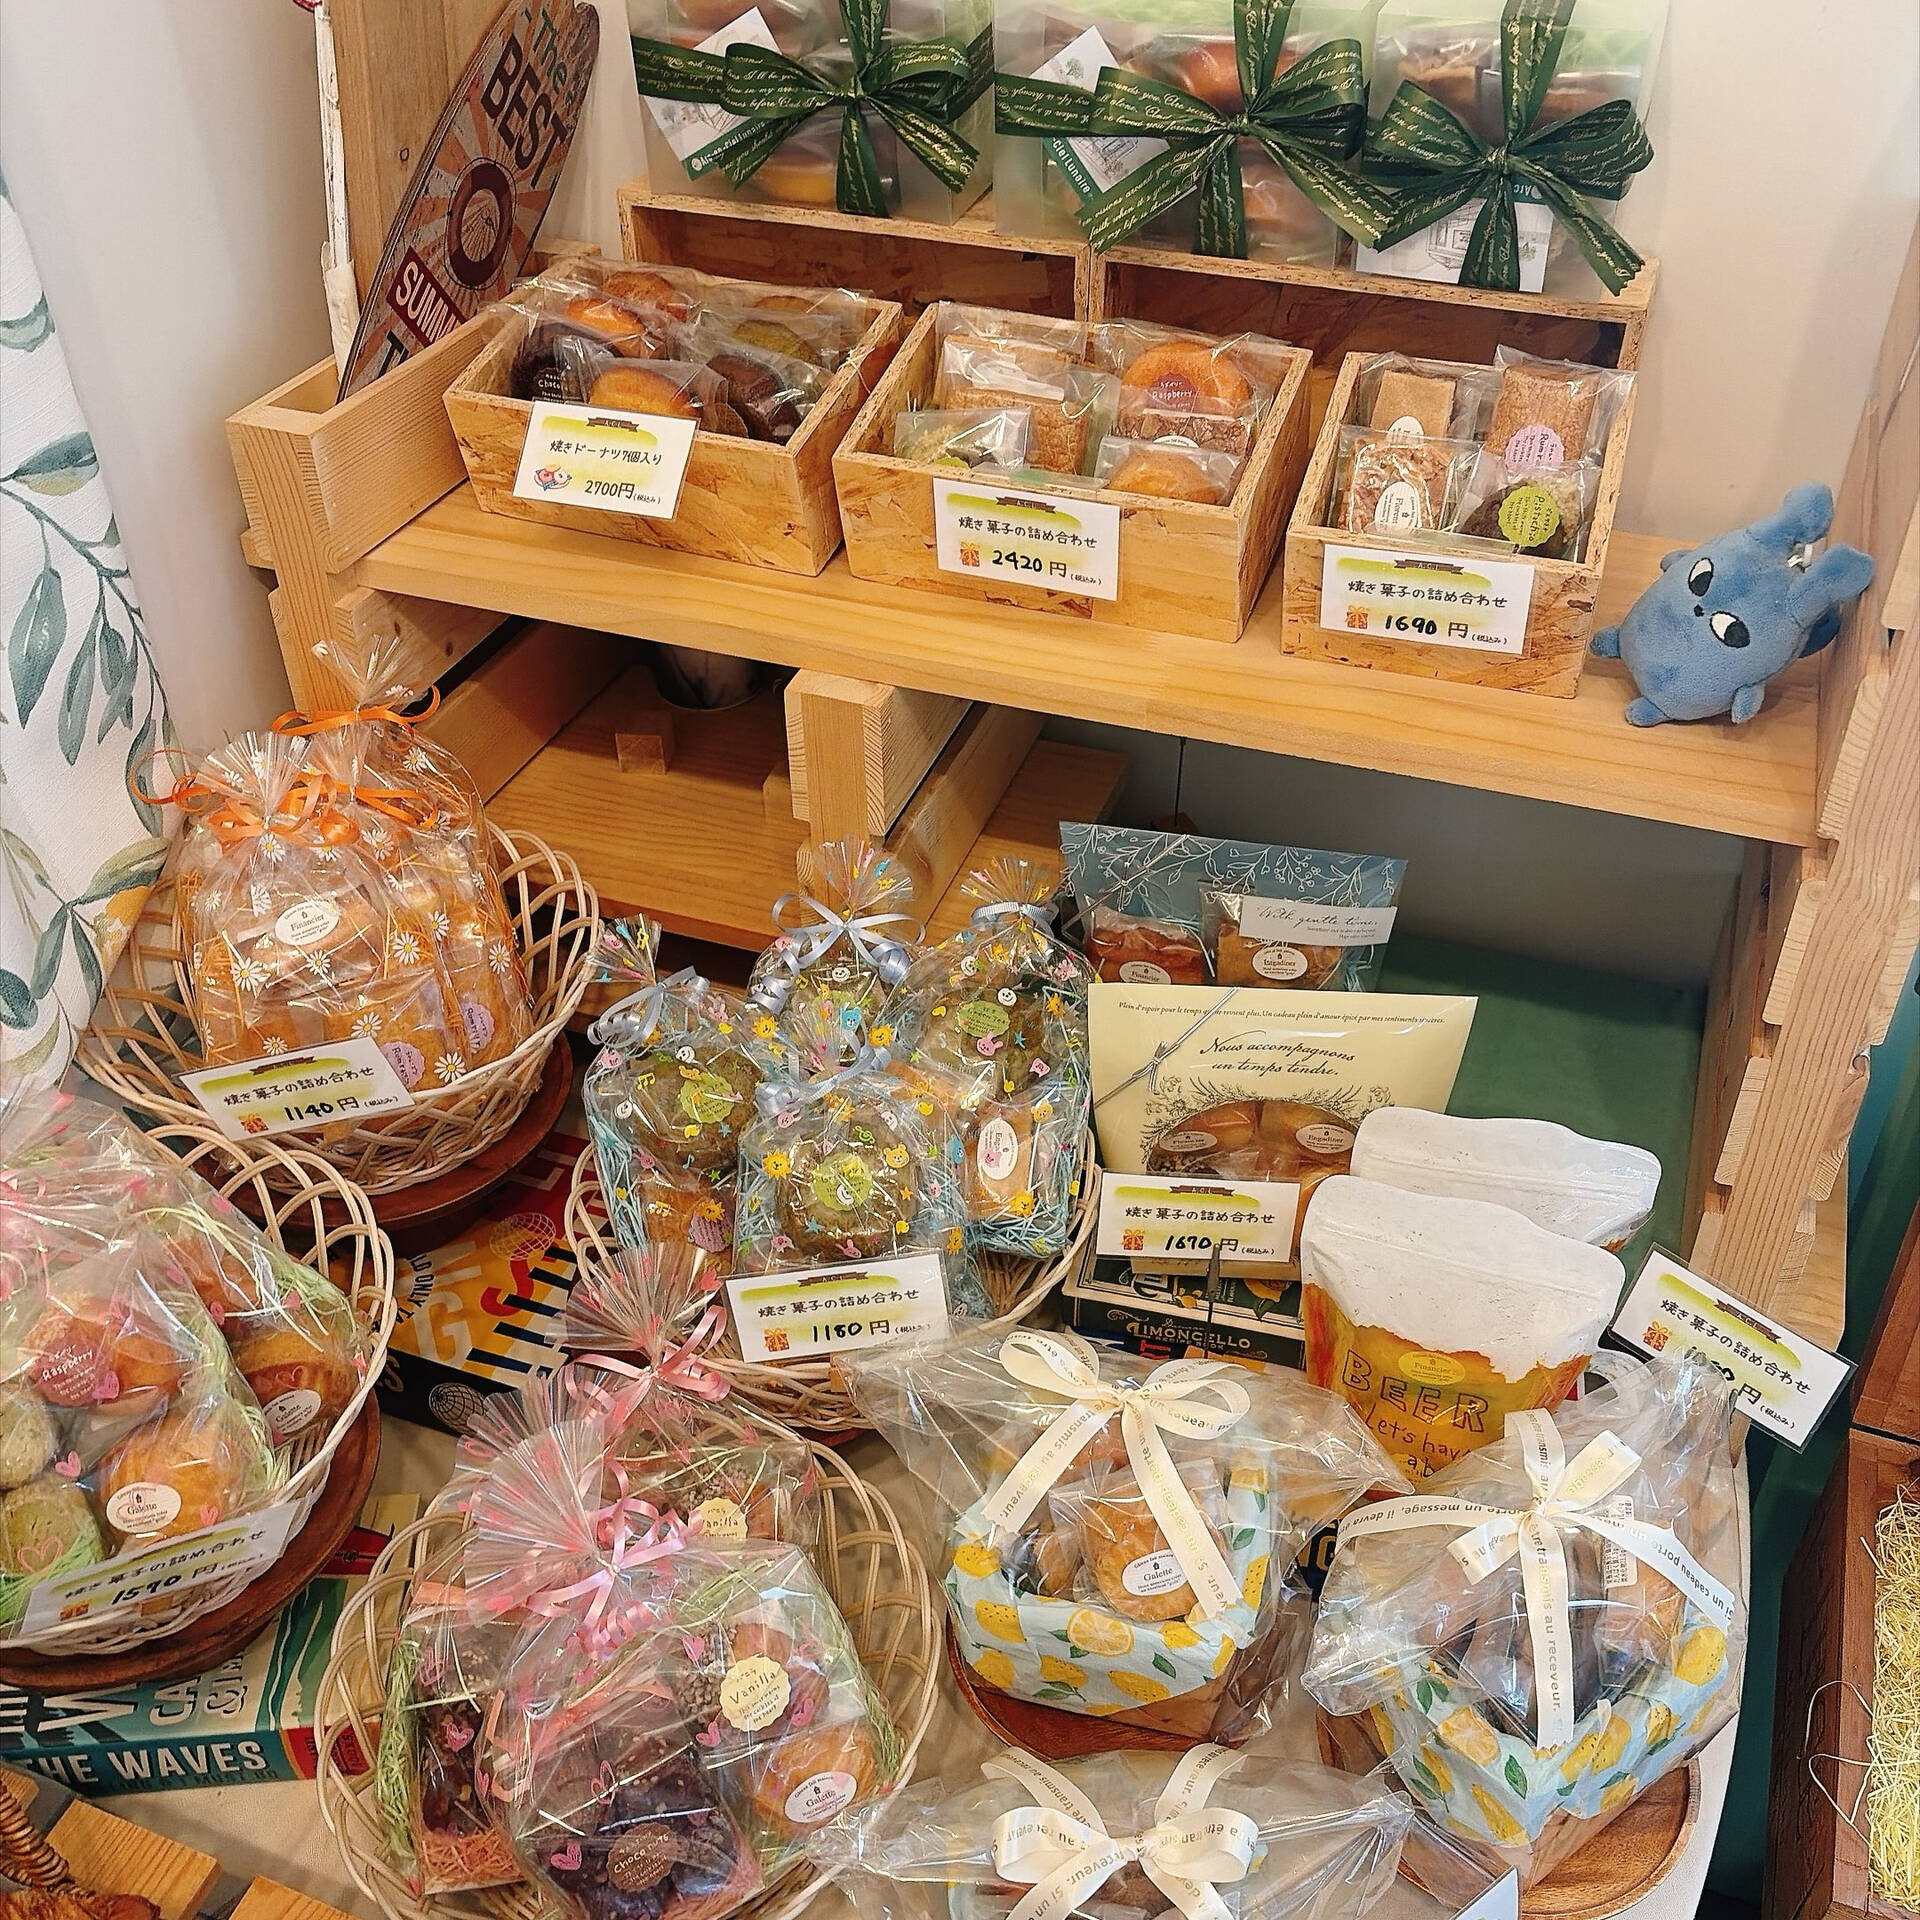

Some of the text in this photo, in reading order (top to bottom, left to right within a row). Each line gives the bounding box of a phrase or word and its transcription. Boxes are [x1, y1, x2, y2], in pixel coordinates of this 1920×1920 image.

[481, 33, 568, 189] BEST
[1064, 156, 1091, 194] Lunaire
[549, 439, 663, 466] 焼きドーナツ7個入り
[957, 516, 1098, 550] 焼き菓子の詰め合わせ
[991, 549, 1044, 574] 2420
[1347, 579, 1509, 609] 焼き菓子の詰め合わせ
[1384, 614, 1438, 636] 1690
[290, 913, 326, 933] Financier
[1118, 1001, 1135, 1010] Plein
[1160, 1007, 1177, 1015] pour
[1273, 1011, 1296, 1019] cadeau
[1296, 1012, 1313, 1021] plein
[1357, 1015, 1371, 1024] par
[1200, 1034, 1356, 1063] Nous accompagnons
[1211, 1057, 1339, 1077] un temps tendre.
[223, 1066, 376, 1107] 焼き菓子の詰め合わせ
[283, 1100, 336, 1121] 1140
[1124, 1205, 1277, 1225] 焼き菓子の詰め合わせ
[757, 1288, 921, 1318] 焼き菓子の詰め合わせ
[811, 1321, 864, 1343] 1180
[1126, 1321, 1252, 1350] LIMONCELLO
[1659, 1298, 1812, 1396] 焼き菓子の詰め合わせ
[1342, 1349, 1489, 1433] BEER
[1364, 1401, 1417, 1445] Let's
[1143, 1567, 1174, 1582] Galette
[729, 1671, 776, 1705] Vanilla
[1548, 1638, 1562, 1714] receveur.
[106, 1740, 269, 1782] WAVES
